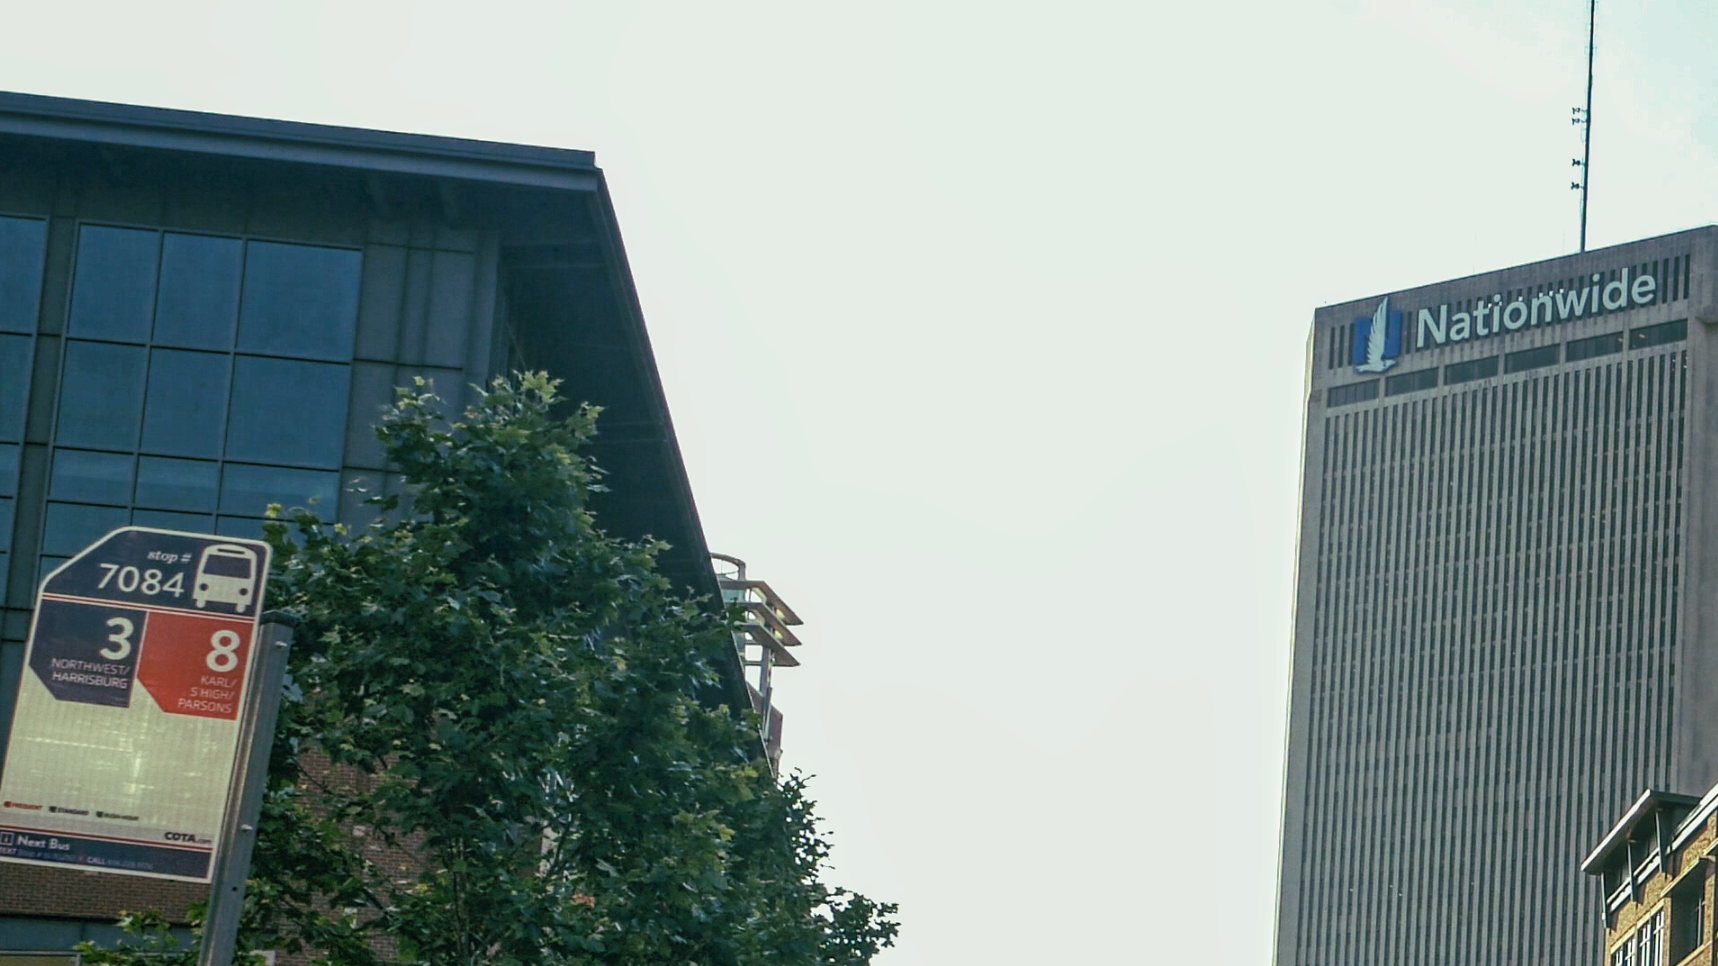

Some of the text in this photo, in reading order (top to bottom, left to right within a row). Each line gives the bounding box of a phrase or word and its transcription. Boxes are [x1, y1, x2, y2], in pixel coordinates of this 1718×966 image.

[1415, 267, 1658, 348] Nationwide
[147, 550, 178, 563] stop
[97, 563, 185, 598] 7084
[100, 617, 134, 661] 3
[205, 629, 240, 673] 8
[51, 657, 131, 675] NORTHWEST/
[52, 671, 129, 689] HARRISBURG
[201, 675, 237, 688] KARL/
[189, 686, 235, 699] S HIGH/
[178, 697, 232, 713] PARSONS
[17, 835, 71, 851] Next Bus
